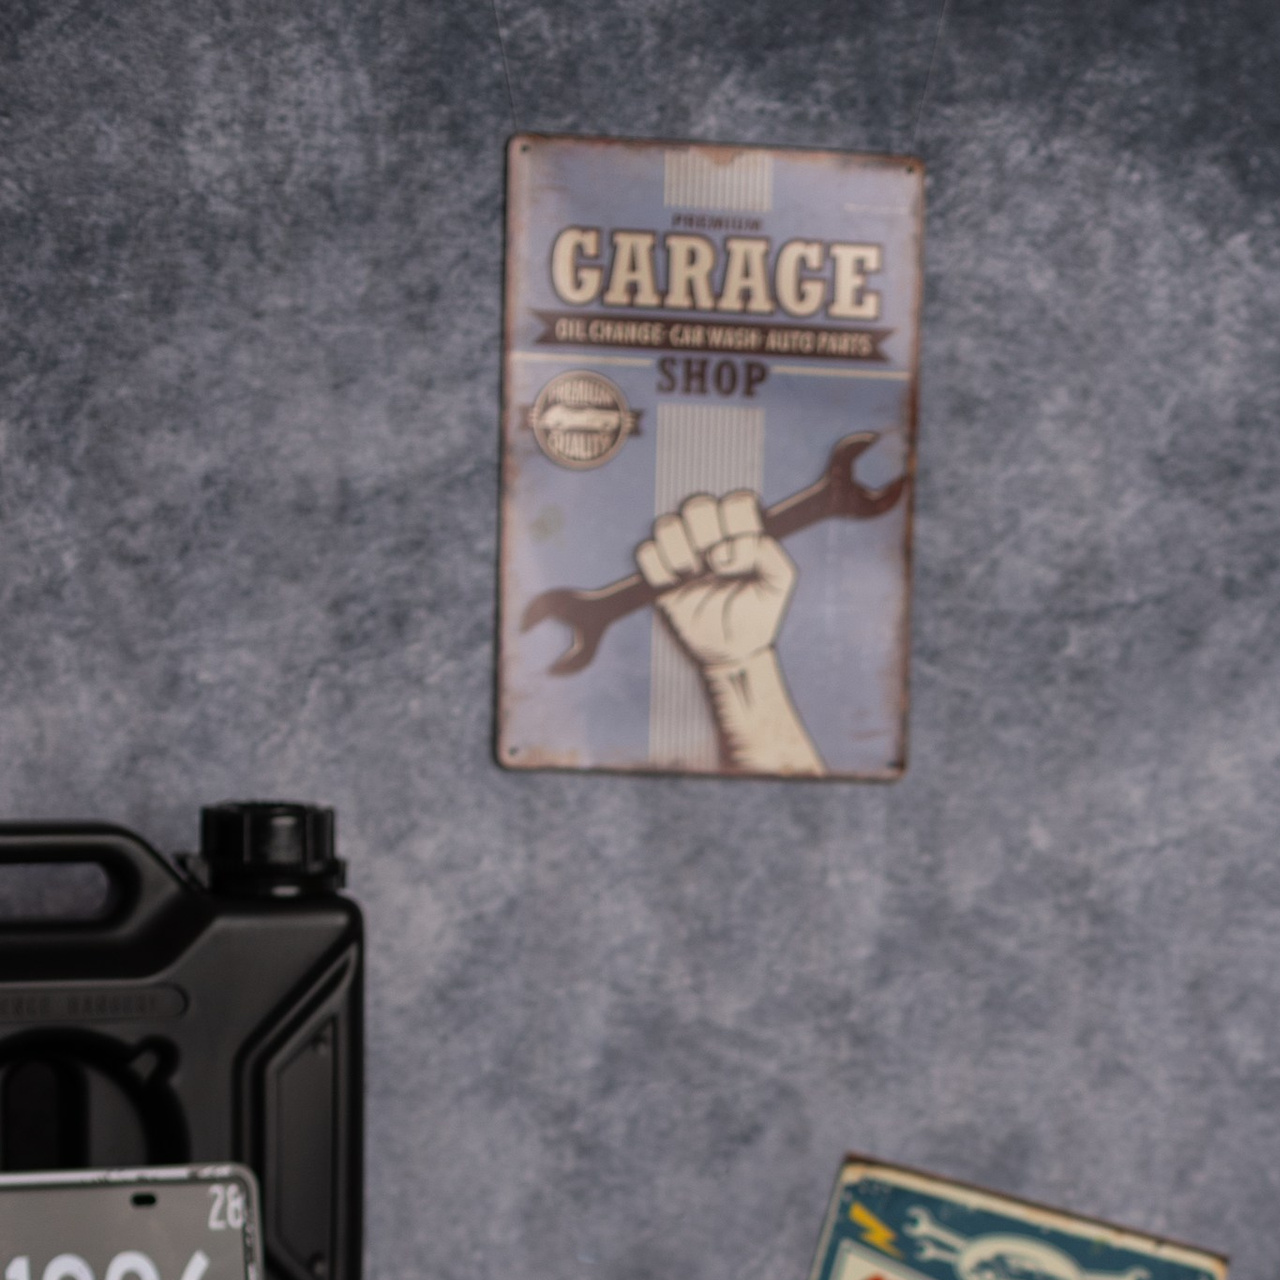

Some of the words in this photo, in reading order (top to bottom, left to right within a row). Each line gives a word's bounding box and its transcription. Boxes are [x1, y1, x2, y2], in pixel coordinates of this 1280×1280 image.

[551, 226, 882, 319] GARAGE
[555, 318, 587, 343] OIL
[588, 319, 664, 346] CHANGE
[669, 323, 708, 348] CAR
[708, 325, 761, 350] WASH
[766, 329, 815, 354] AUTO
[817, 331, 873, 356] PARTS
[656, 356, 771, 397] SHOP
